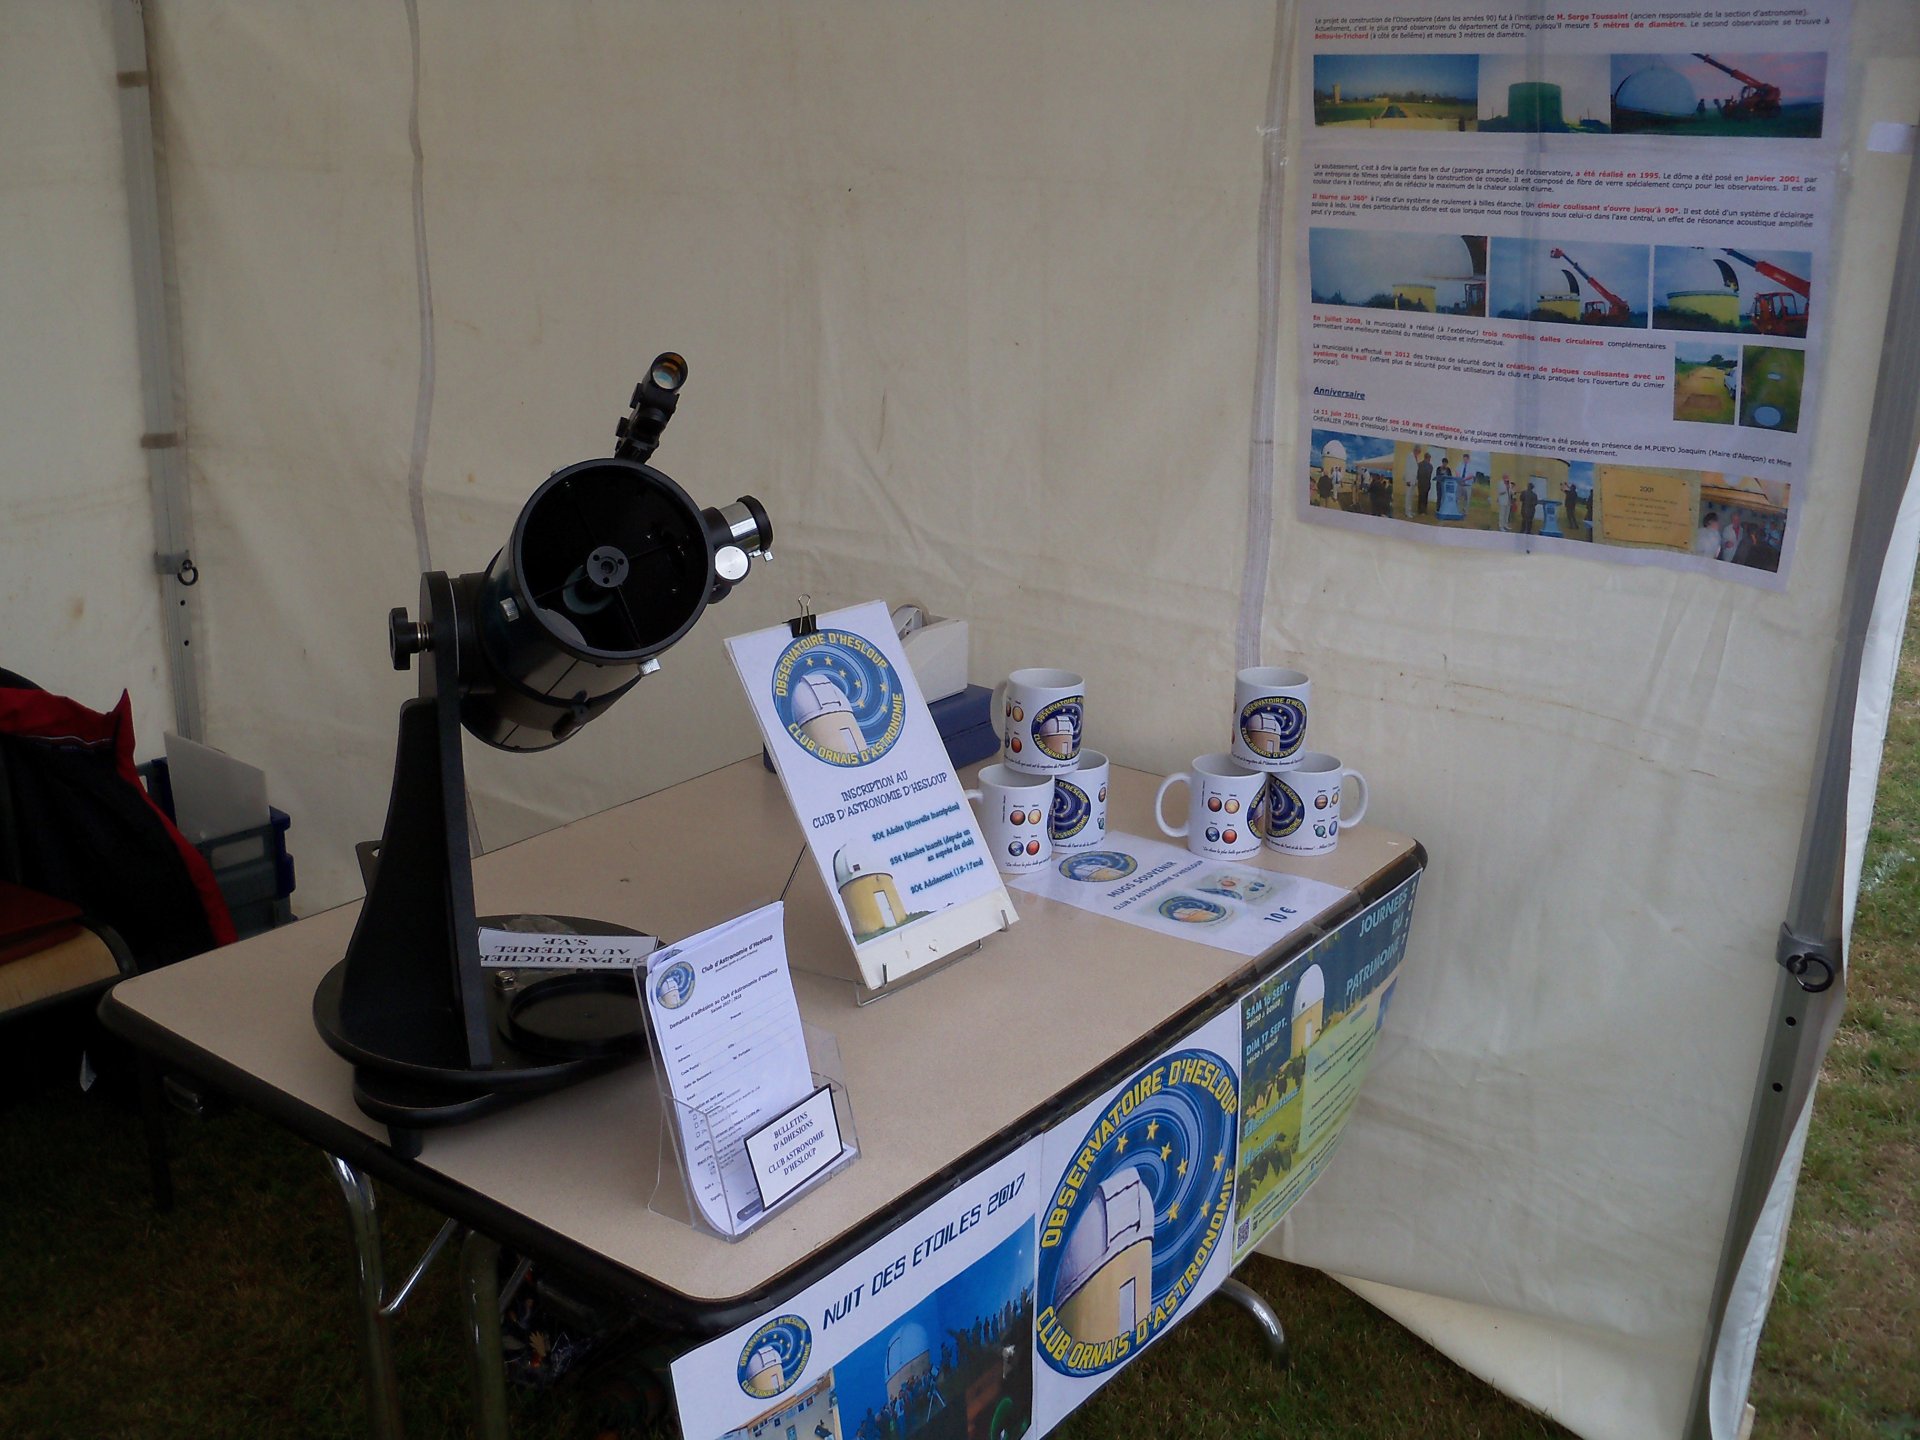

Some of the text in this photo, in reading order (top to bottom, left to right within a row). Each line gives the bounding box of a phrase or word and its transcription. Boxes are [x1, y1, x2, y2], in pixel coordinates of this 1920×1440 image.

[1567, 13, 1589, 21] Serge
[1630, 12, 1656, 20] (ancien
[1658, 11, 1701, 19] responsable
[1626, 180, 1669, 188] spécialement
[1727, 183, 1779, 191] observatoires.
[1745, 174, 1775, 182] janvier
[1736, 219, 1775, 227] acoustique
[1539, 335, 1560, 343] dalles
[1565, 337, 1603, 345] circulaires
[1607, 340, 1666, 349] complémentaires
[1582, 369, 1628, 378] coulissantes
[1592, 378, 1629, 386] l'ouverture
[1313, 386, 1366, 401] Anniversaire
[1601, 441, 1631, 449] présence
[1708, 450, 1730, 458] (Maire
[775, 632, 887, 696] OBSERVATOIRE D'HESLOUP
[788, 693, 904, 765] CLUB ORNAIS D'ASTRONOMIE
[841, 770, 908, 802] INSCRIPTION AU
[812, 772, 948, 829] CLUB D'ASTRONOMIE D'HESLOUP
[1106, 860, 1177, 898] MUGS SOUVENIR
[1113, 898, 1131, 911] CLUB
[1264, 906, 1297, 922] 10 €
[1359, 888, 1408, 937] JOURNEES
[495, 946, 596, 955] MATERIEL
[544, 938, 588, 946] S.V.P.
[481, 954, 573, 963] TOUCHER
[578, 956, 613, 964] PAS
[701, 963, 714, 974] Club
[714, 947, 748, 968] d'Astronomie
[1346, 936, 1400, 996] PATRIMOINE
[1245, 1001, 1263, 1020] SAM
[1271, 980, 1291, 1002] SEPT.
[1245, 1036, 1262, 1056] DIM
[1261, 1031, 1270, 1044] 17
[1268, 1017, 1287, 1040] SEPT.
[773, 1111, 808, 1139] BULLETINS
[773, 1120, 814, 1151] D'ADHESIONS
[767, 1155, 786, 1174] CLUB
[785, 1129, 825, 1163] ASTRONOMIE
[783, 1147, 817, 1176] D'HESLOUP
[1041, 1065, 1166, 1249] OBSERVATOIRE
[1167, 1058, 1239, 1115] D'HESLOUP
[822, 1172, 1026, 1331] NUIT DES ETOILES 2017
[1036, 1305, 1071, 1362] CLUB
[1067, 1331, 1131, 1371] ORNAIS
[1135, 1167, 1235, 1341] D'ASTRONOMIE
[741, 1320, 777, 1366] OBSERVATOIRE
